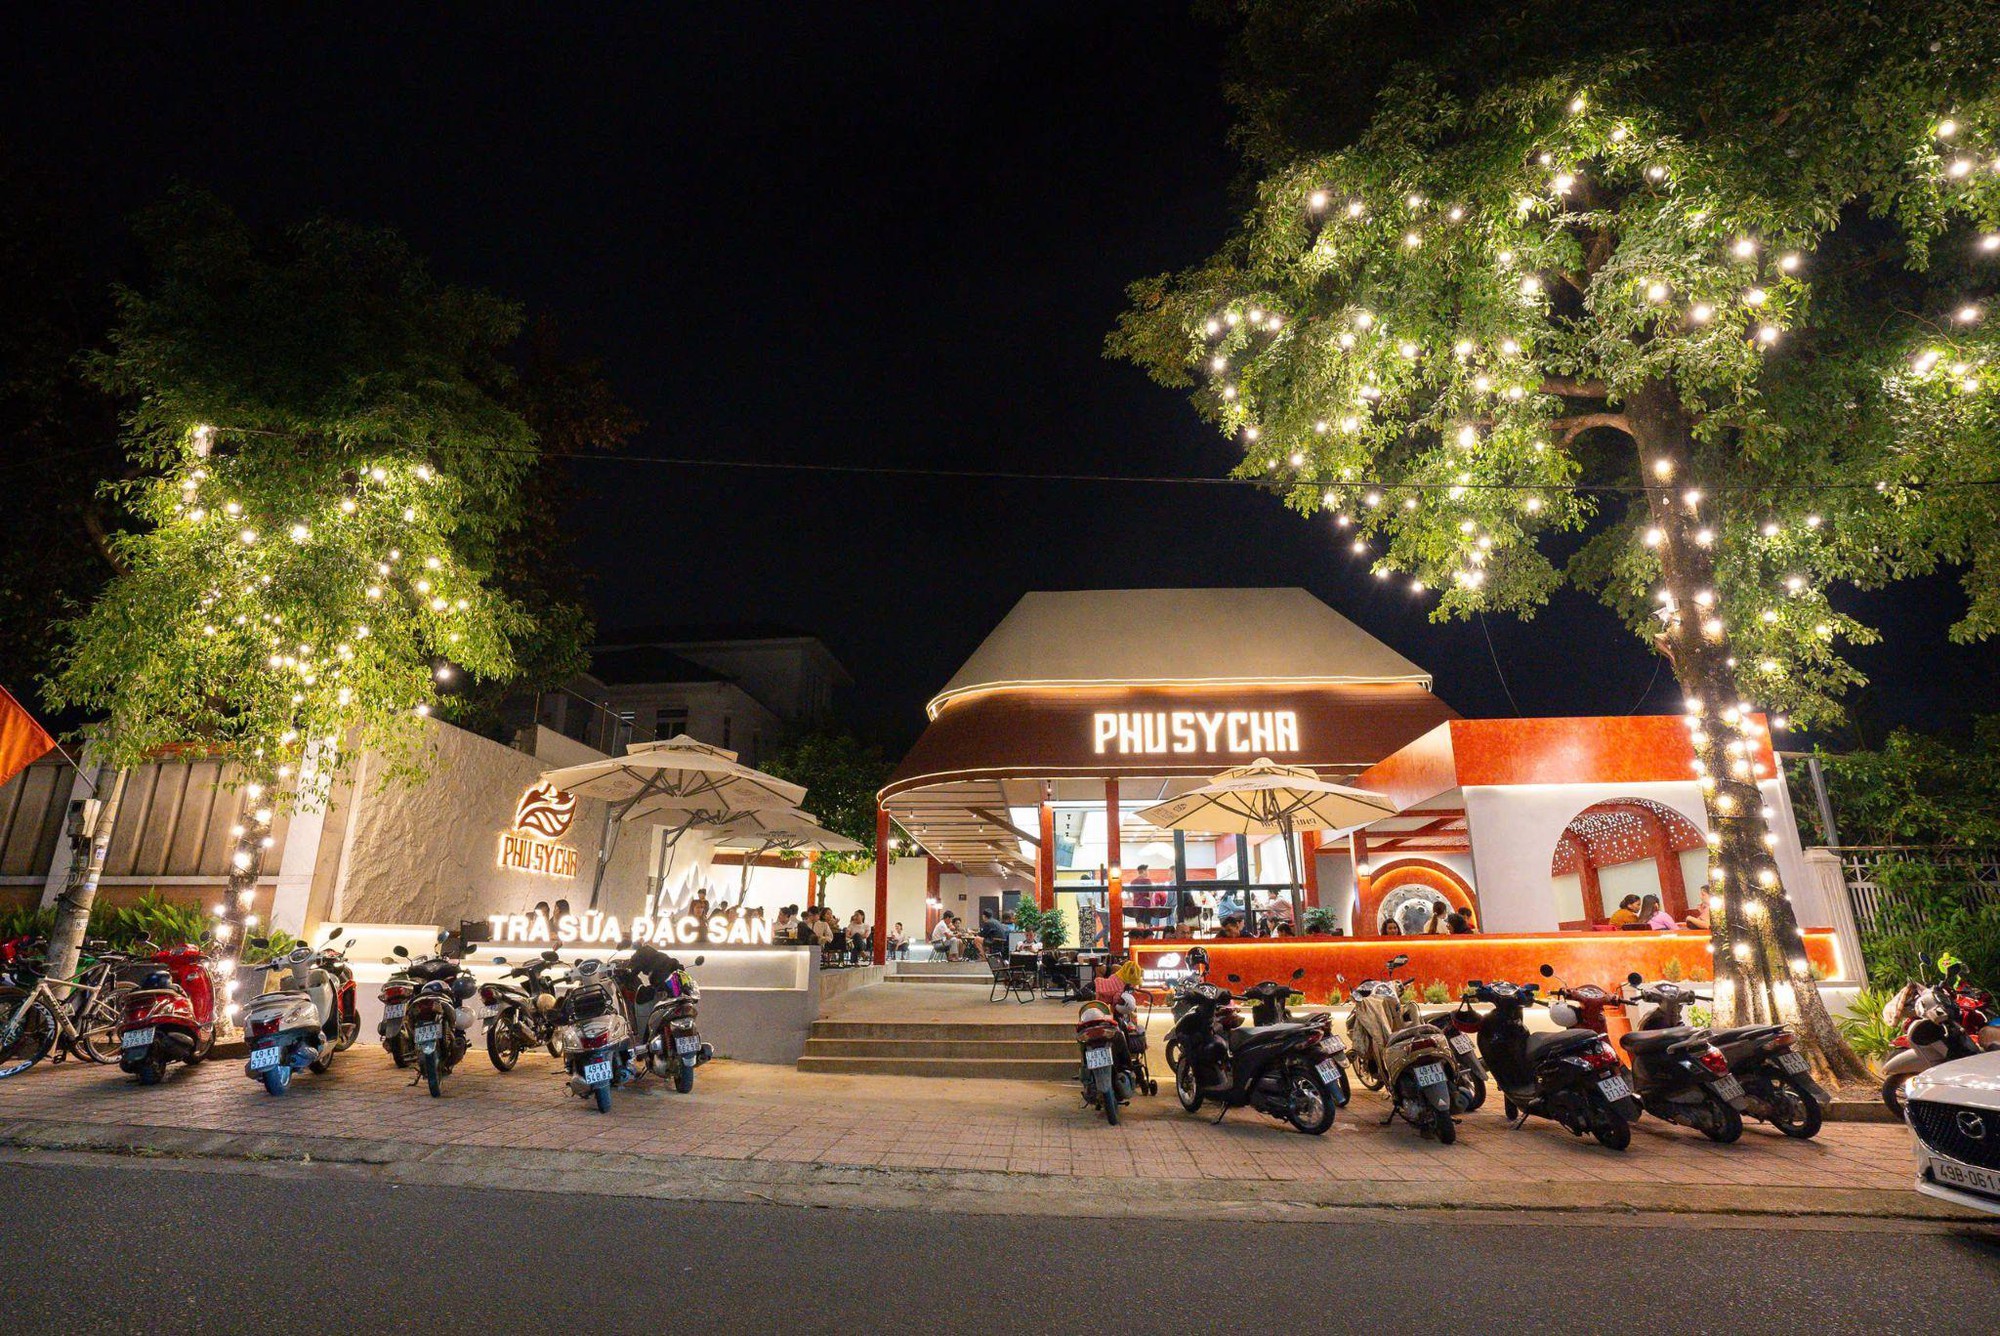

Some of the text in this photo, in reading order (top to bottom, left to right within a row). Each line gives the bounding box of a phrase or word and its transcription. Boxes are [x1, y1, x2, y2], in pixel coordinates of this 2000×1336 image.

[489, 906, 772, 947] TRÀ SỮA ĐẶC SẢN
[255, 1047, 275, 1058] 49-K1
[252, 1056, 278, 1068] 57977
[589, 1062, 608, 1073] 49-K1
[1420, 1064, 1439, 1075] 49-K1
[586, 1070, 611, 1083] 54882
[1420, 1072, 1444, 1085] 50407
[1602, 1077, 1622, 1088] 49-K1
